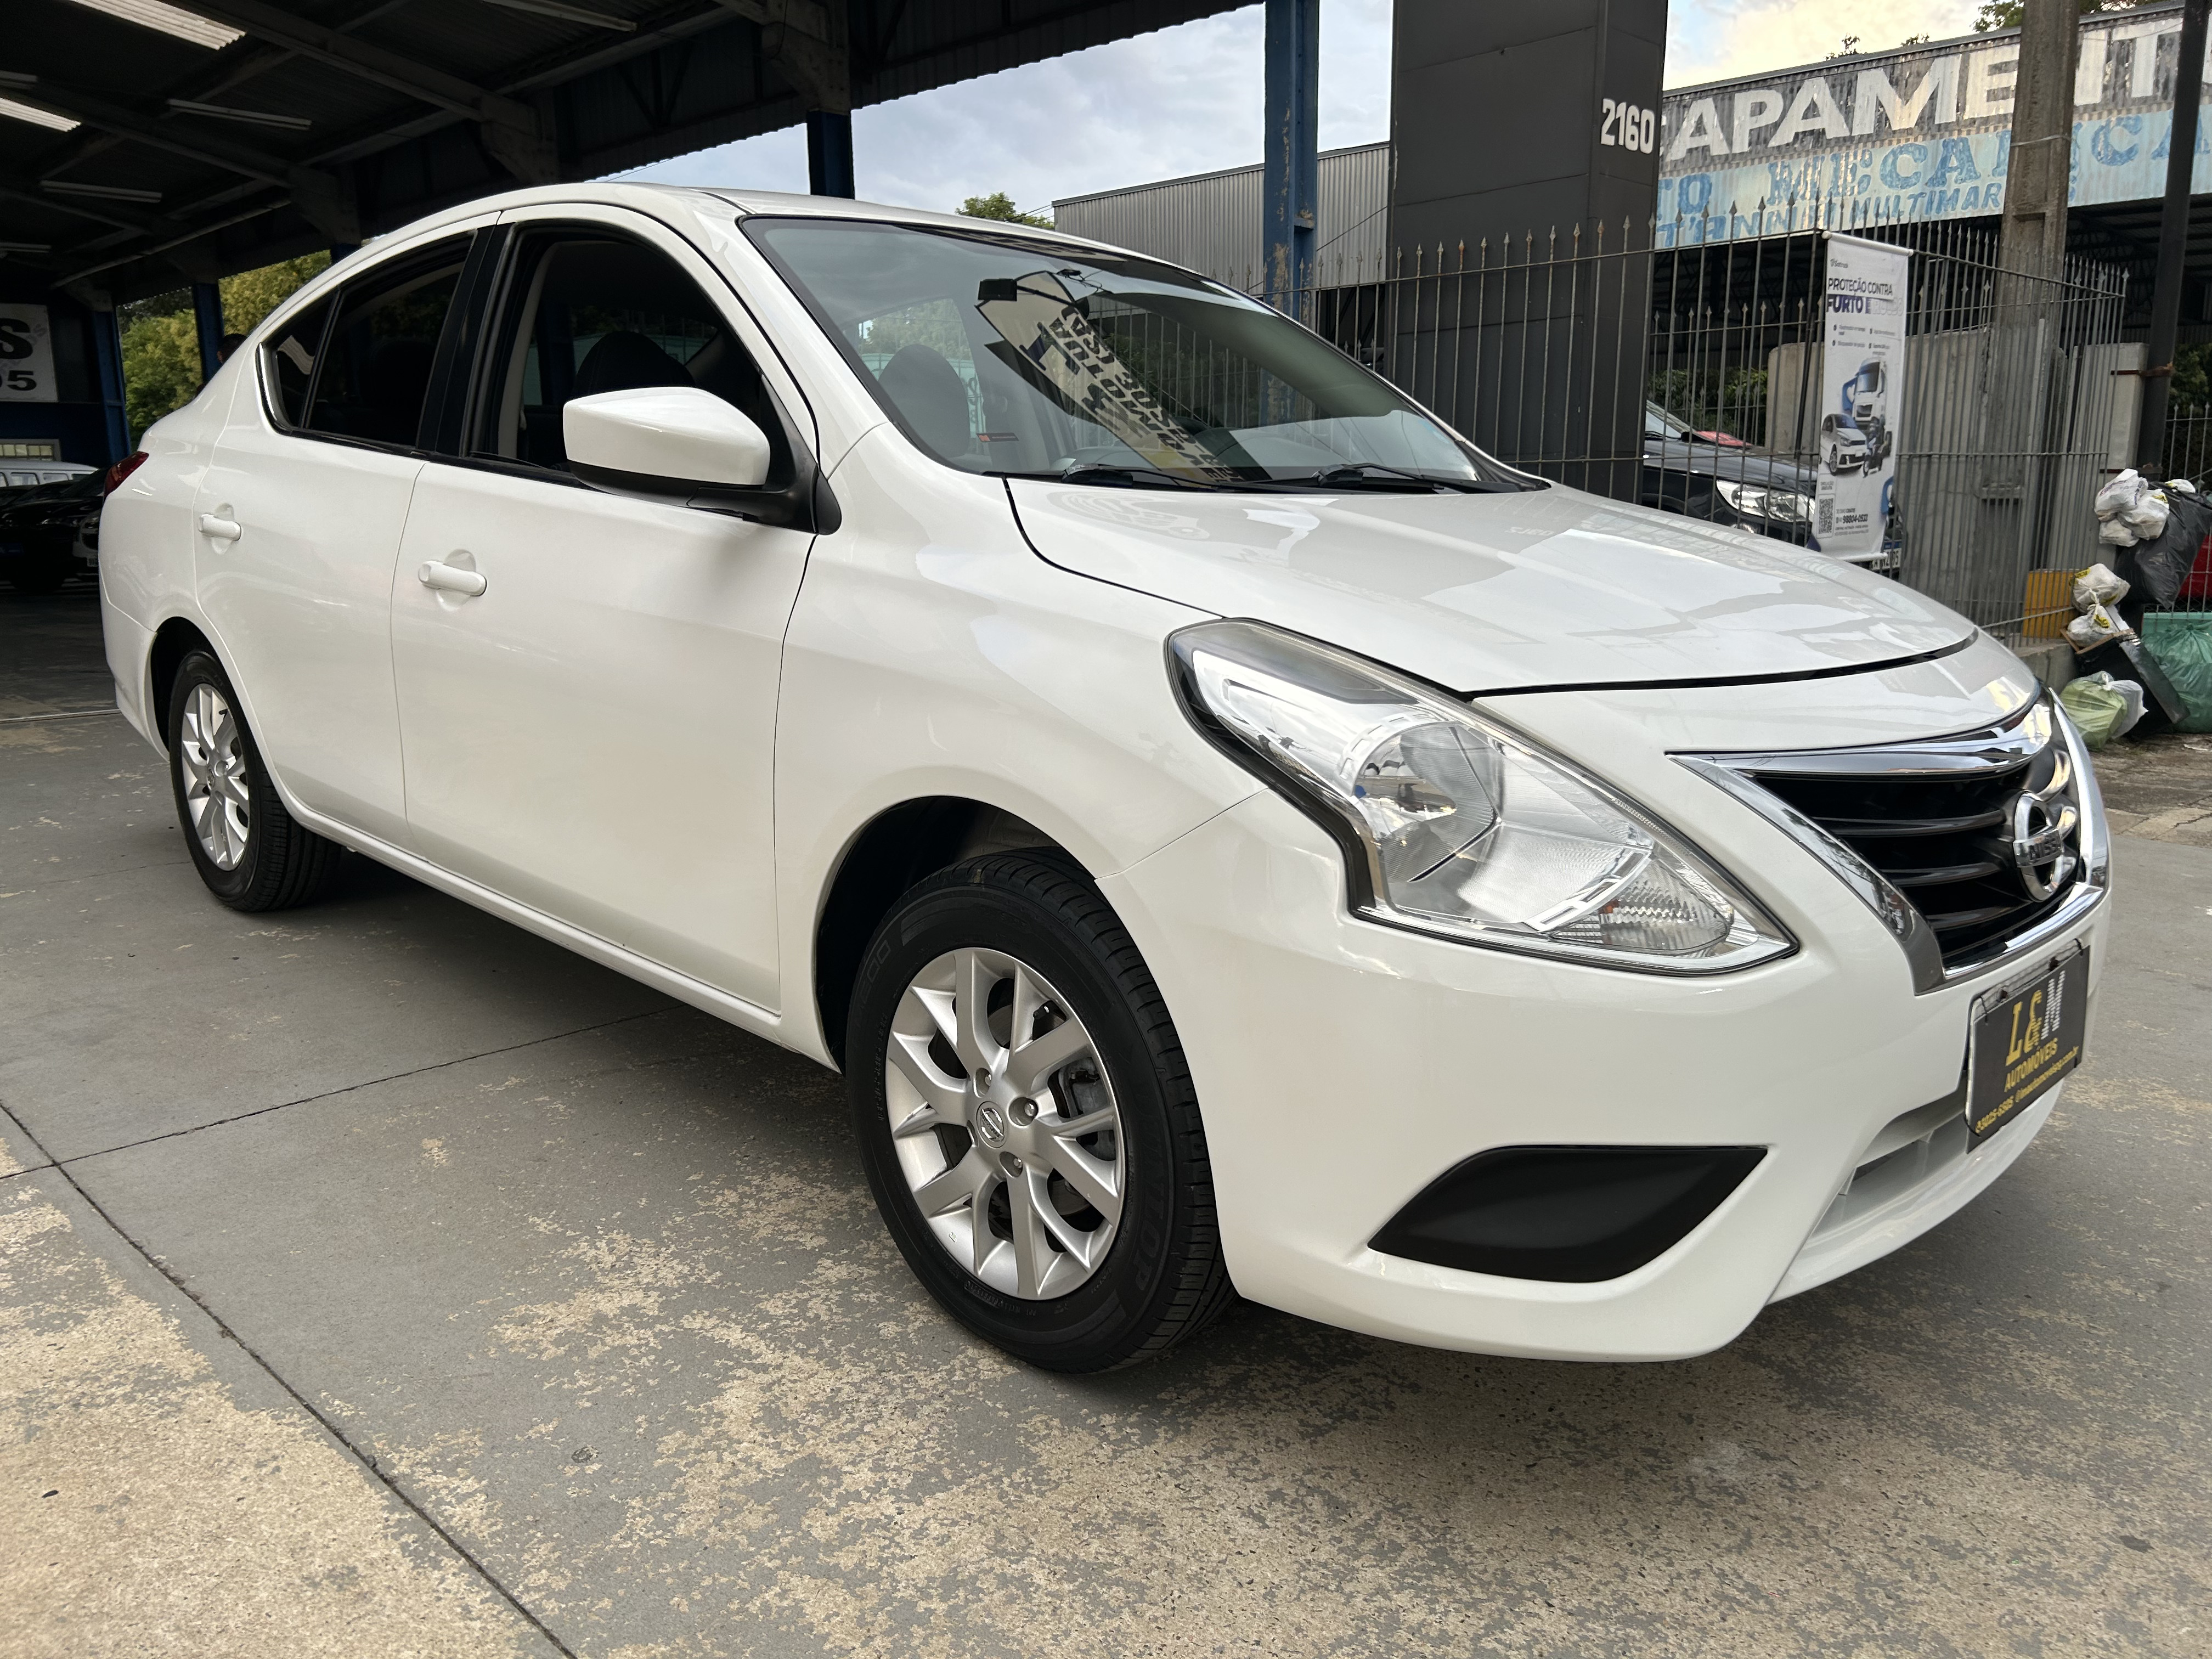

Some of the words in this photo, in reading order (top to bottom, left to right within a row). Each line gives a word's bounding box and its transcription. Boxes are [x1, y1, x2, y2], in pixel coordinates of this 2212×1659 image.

[1601, 98, 1655, 154] 2160
[1826, 294, 1864, 313] FURTO
[1827, 277, 1867, 295] PROTEÇÃO
[1867, 281, 1893, 296] CONTRA
[0, 370, 37, 391] 5
[2005, 970, 2066, 1066] L&M
[2004, 1037, 2058, 1093] AUTOMÓVEIS
